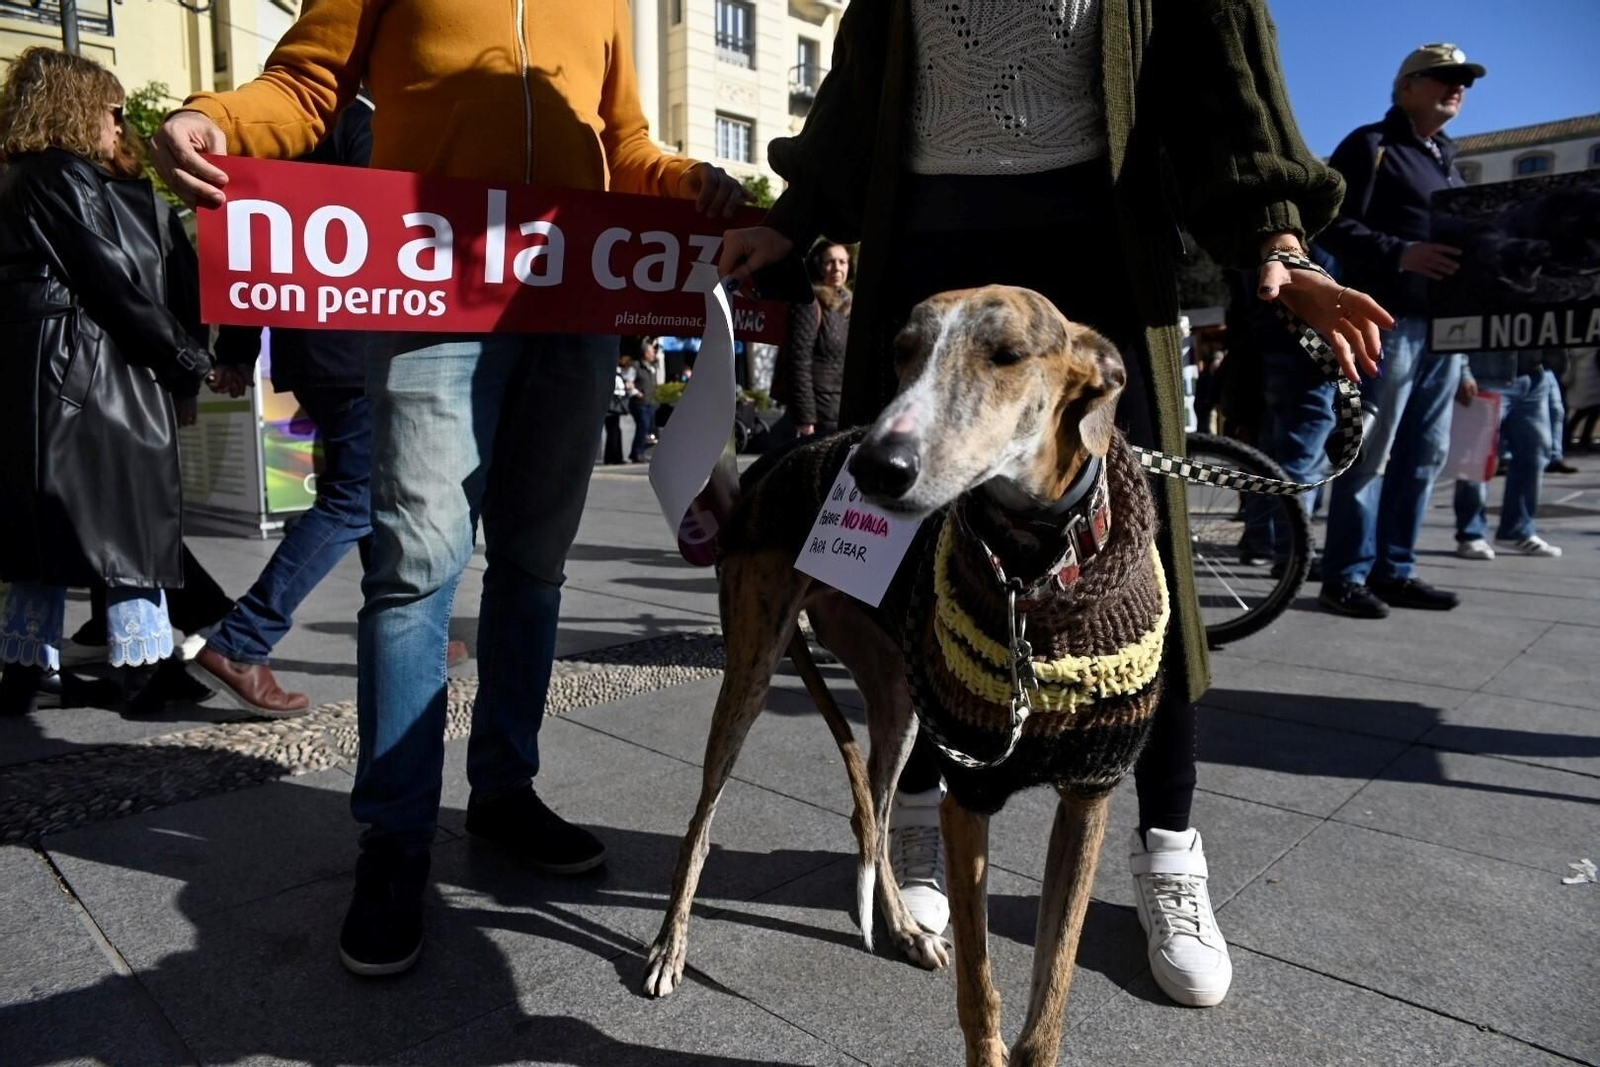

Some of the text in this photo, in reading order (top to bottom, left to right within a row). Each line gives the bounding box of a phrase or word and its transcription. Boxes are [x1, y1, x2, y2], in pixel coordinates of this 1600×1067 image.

[227, 188, 724, 293] no a la caz
[228, 281, 447, 323] con perros
[614, 310, 707, 328] plataformanac.
[1489, 307, 1600, 349] NO A LA
[831, 537, 868, 563] CAZAR
